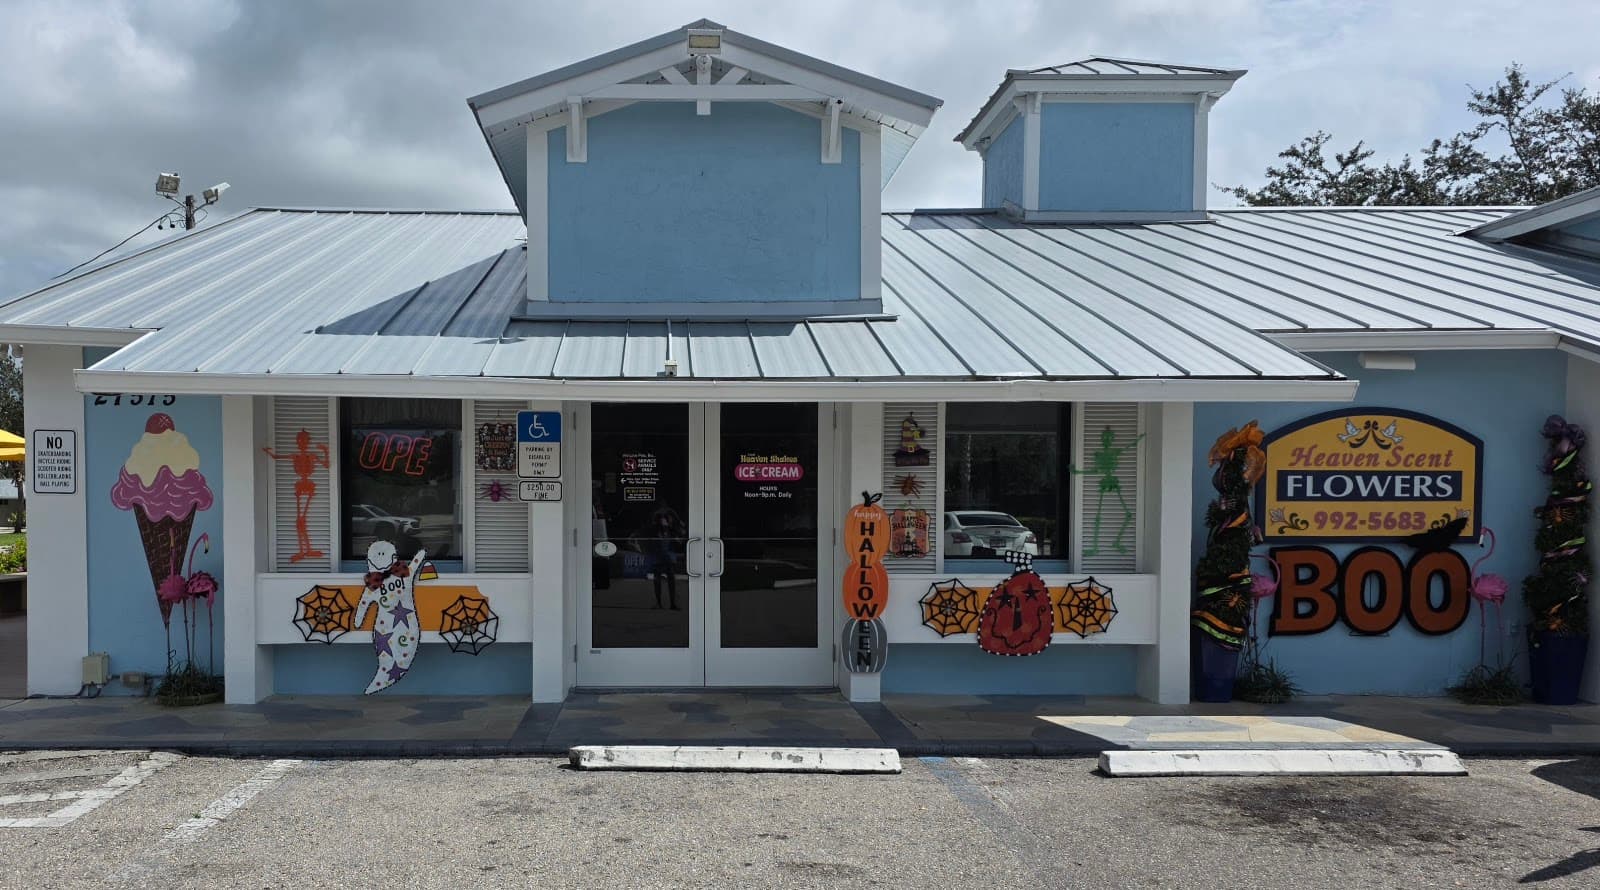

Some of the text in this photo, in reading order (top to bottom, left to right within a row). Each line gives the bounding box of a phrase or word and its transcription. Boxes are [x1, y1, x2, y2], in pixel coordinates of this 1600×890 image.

[46, 436, 63, 449] NO
[1288, 444, 1454, 468] Heaven Scent
[738, 466, 799, 478] ICE CREAM
[1287, 475, 1454, 498] FLOWERS
[1314, 511, 1426, 531] 992-5683
[852, 521, 878, 666] HALLOWEEN
[1269, 545, 1472, 637] BOO
